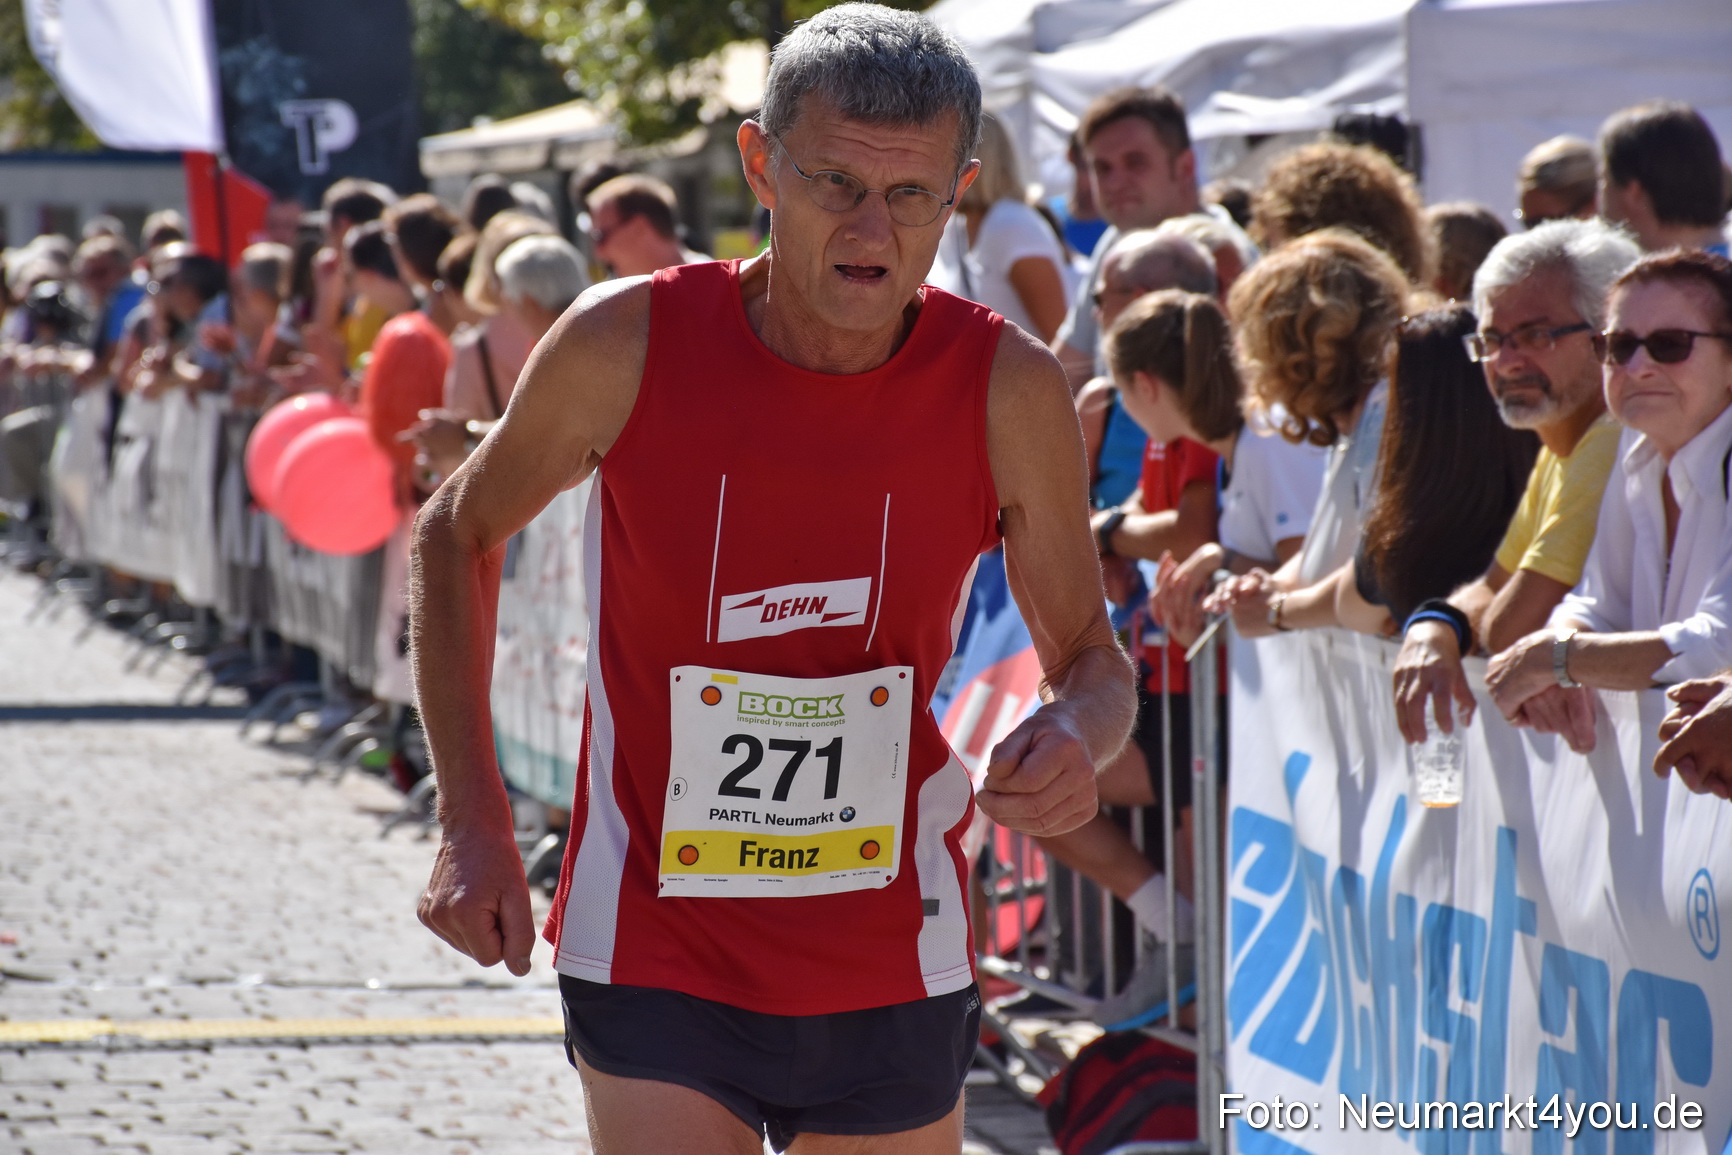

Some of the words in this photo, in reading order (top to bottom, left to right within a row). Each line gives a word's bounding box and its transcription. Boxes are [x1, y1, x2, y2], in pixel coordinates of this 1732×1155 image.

[760, 596, 828, 623] DEHN
[738, 691, 845, 719] BOCK
[737, 715, 770, 725] inspired
[772, 718, 783, 727] by
[785, 720, 809, 728] smart
[811, 718, 846, 728] concepts
[717, 733, 843, 802] 271
[673, 783, 681, 795] B
[709, 808, 761, 824] PARTL
[765, 811, 834, 826] Neumarkt
[739, 840, 820, 869] Franz
